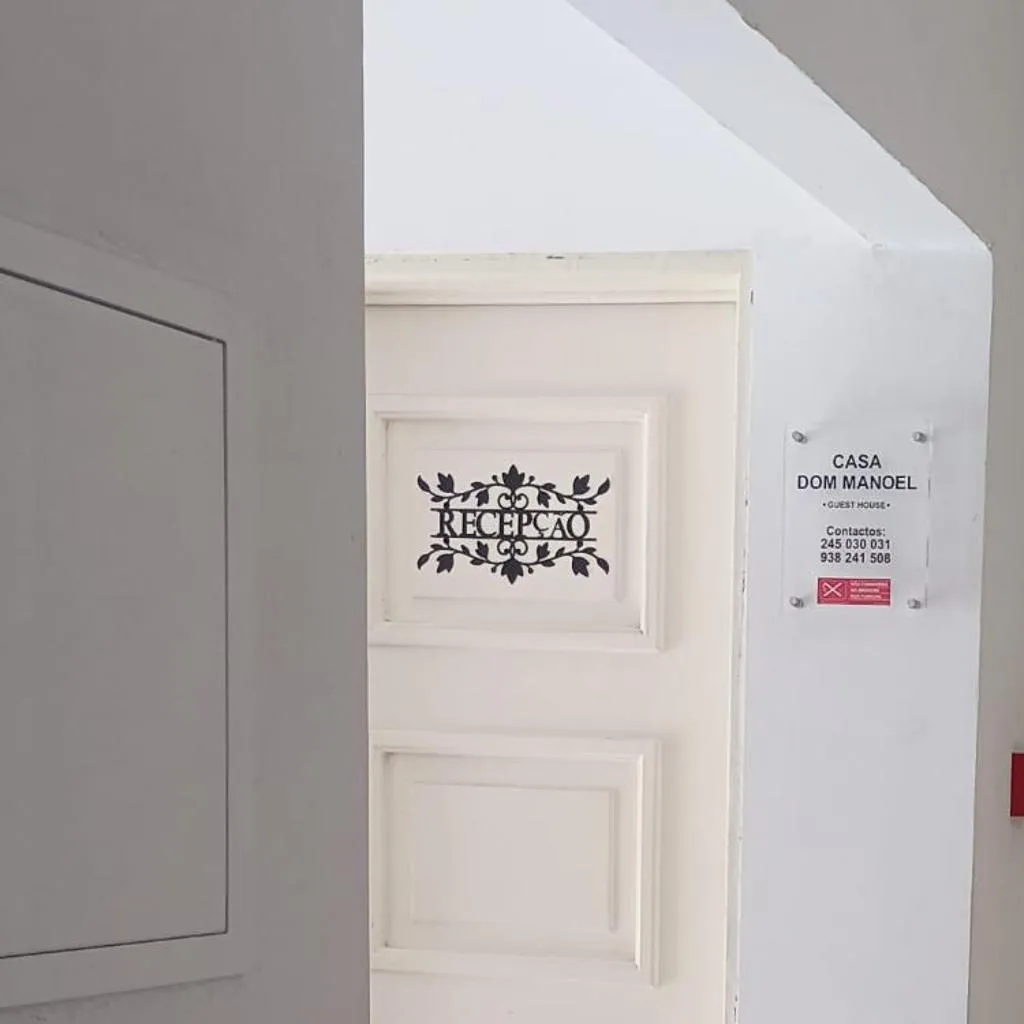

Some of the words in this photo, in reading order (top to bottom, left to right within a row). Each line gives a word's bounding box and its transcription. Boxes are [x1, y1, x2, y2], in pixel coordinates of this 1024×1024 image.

[832, 454, 882, 469] CASA
[797, 474, 837, 490] DOM
[842, 474, 917, 490] MANOEL
[827, 501, 855, 509] GUEST
[857, 501, 886, 509] HOUSE
[826, 526, 886, 537] Contactos:
[820, 538, 842, 549] 245
[845, 538, 867, 550] 030
[870, 538, 891, 550] 031
[820, 552, 842, 563] 938
[845, 552, 866, 563] 241
[870, 552, 892, 564] 508
